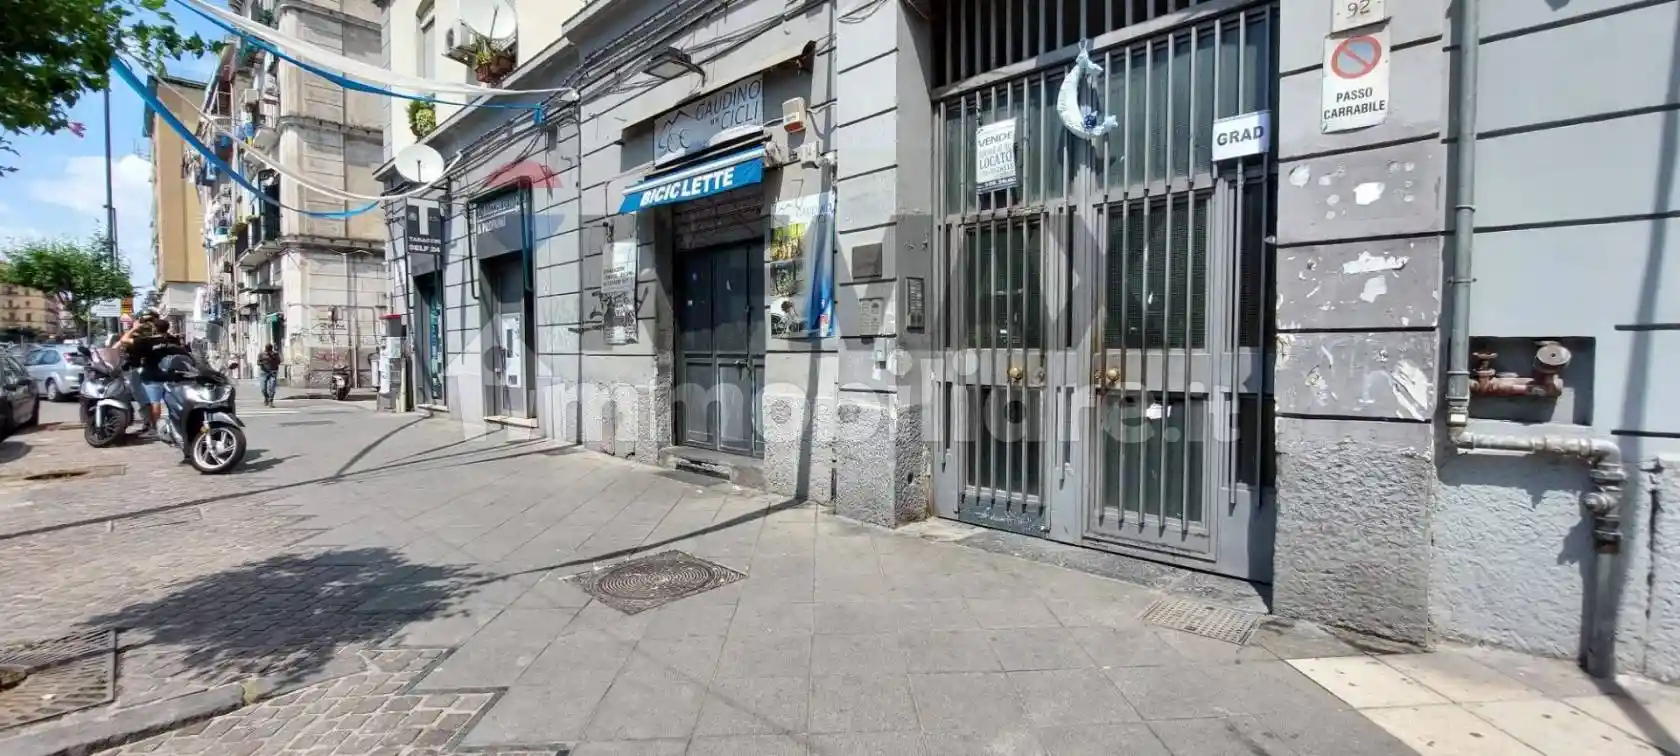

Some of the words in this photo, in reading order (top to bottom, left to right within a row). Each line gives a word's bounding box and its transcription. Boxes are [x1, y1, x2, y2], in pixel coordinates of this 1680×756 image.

[1347, 0, 1370, 19] 92
[695, 79, 761, 122] GAUDINO
[1336, 87, 1373, 103] PASSO
[720, 101, 759, 130] CICLI
[1324, 99, 1386, 120] CARRABILE
[1217, 125, 1265, 146] GRAD
[640, 167, 735, 207] BICICLETTE
